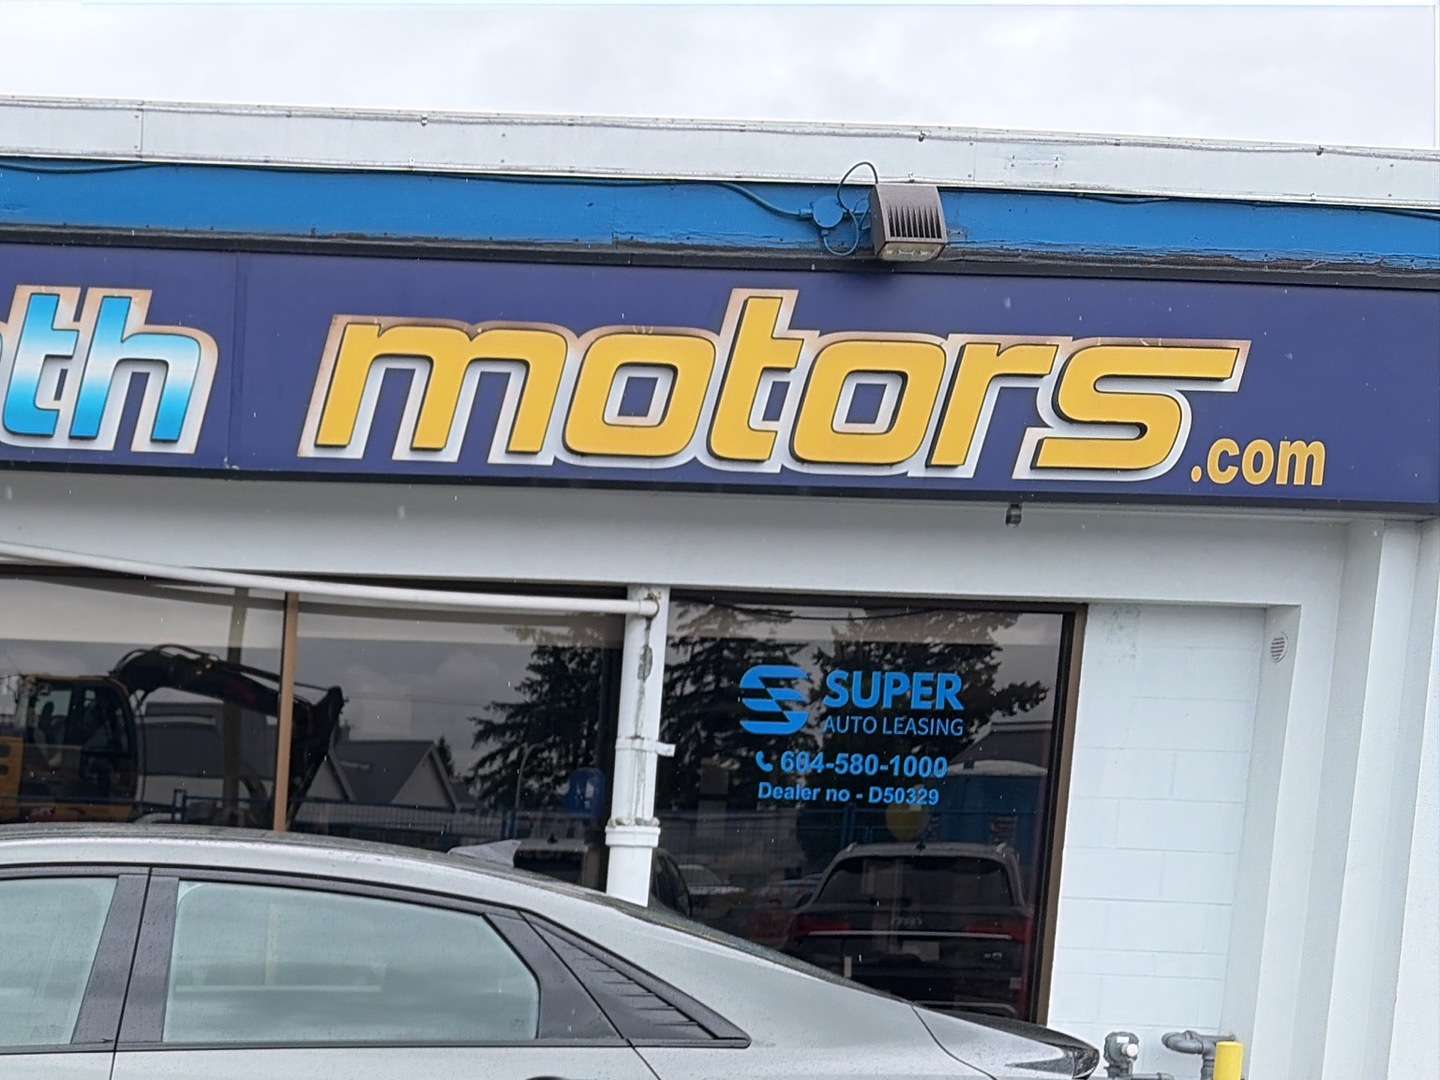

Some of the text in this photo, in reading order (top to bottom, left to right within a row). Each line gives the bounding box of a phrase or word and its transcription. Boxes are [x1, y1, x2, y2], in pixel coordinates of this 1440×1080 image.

[308, 292, 1246, 474] motors
[1190, 437, 1326, 486] .com
[823, 669, 964, 711] SUPER
[823, 715, 964, 737] AUTO LEASING
[780, 751, 948, 779] 604-580-1000
[758, 782, 820, 800] Dealer
[826, 788, 850, 803] no
[868, 787, 940, 806] D50329
